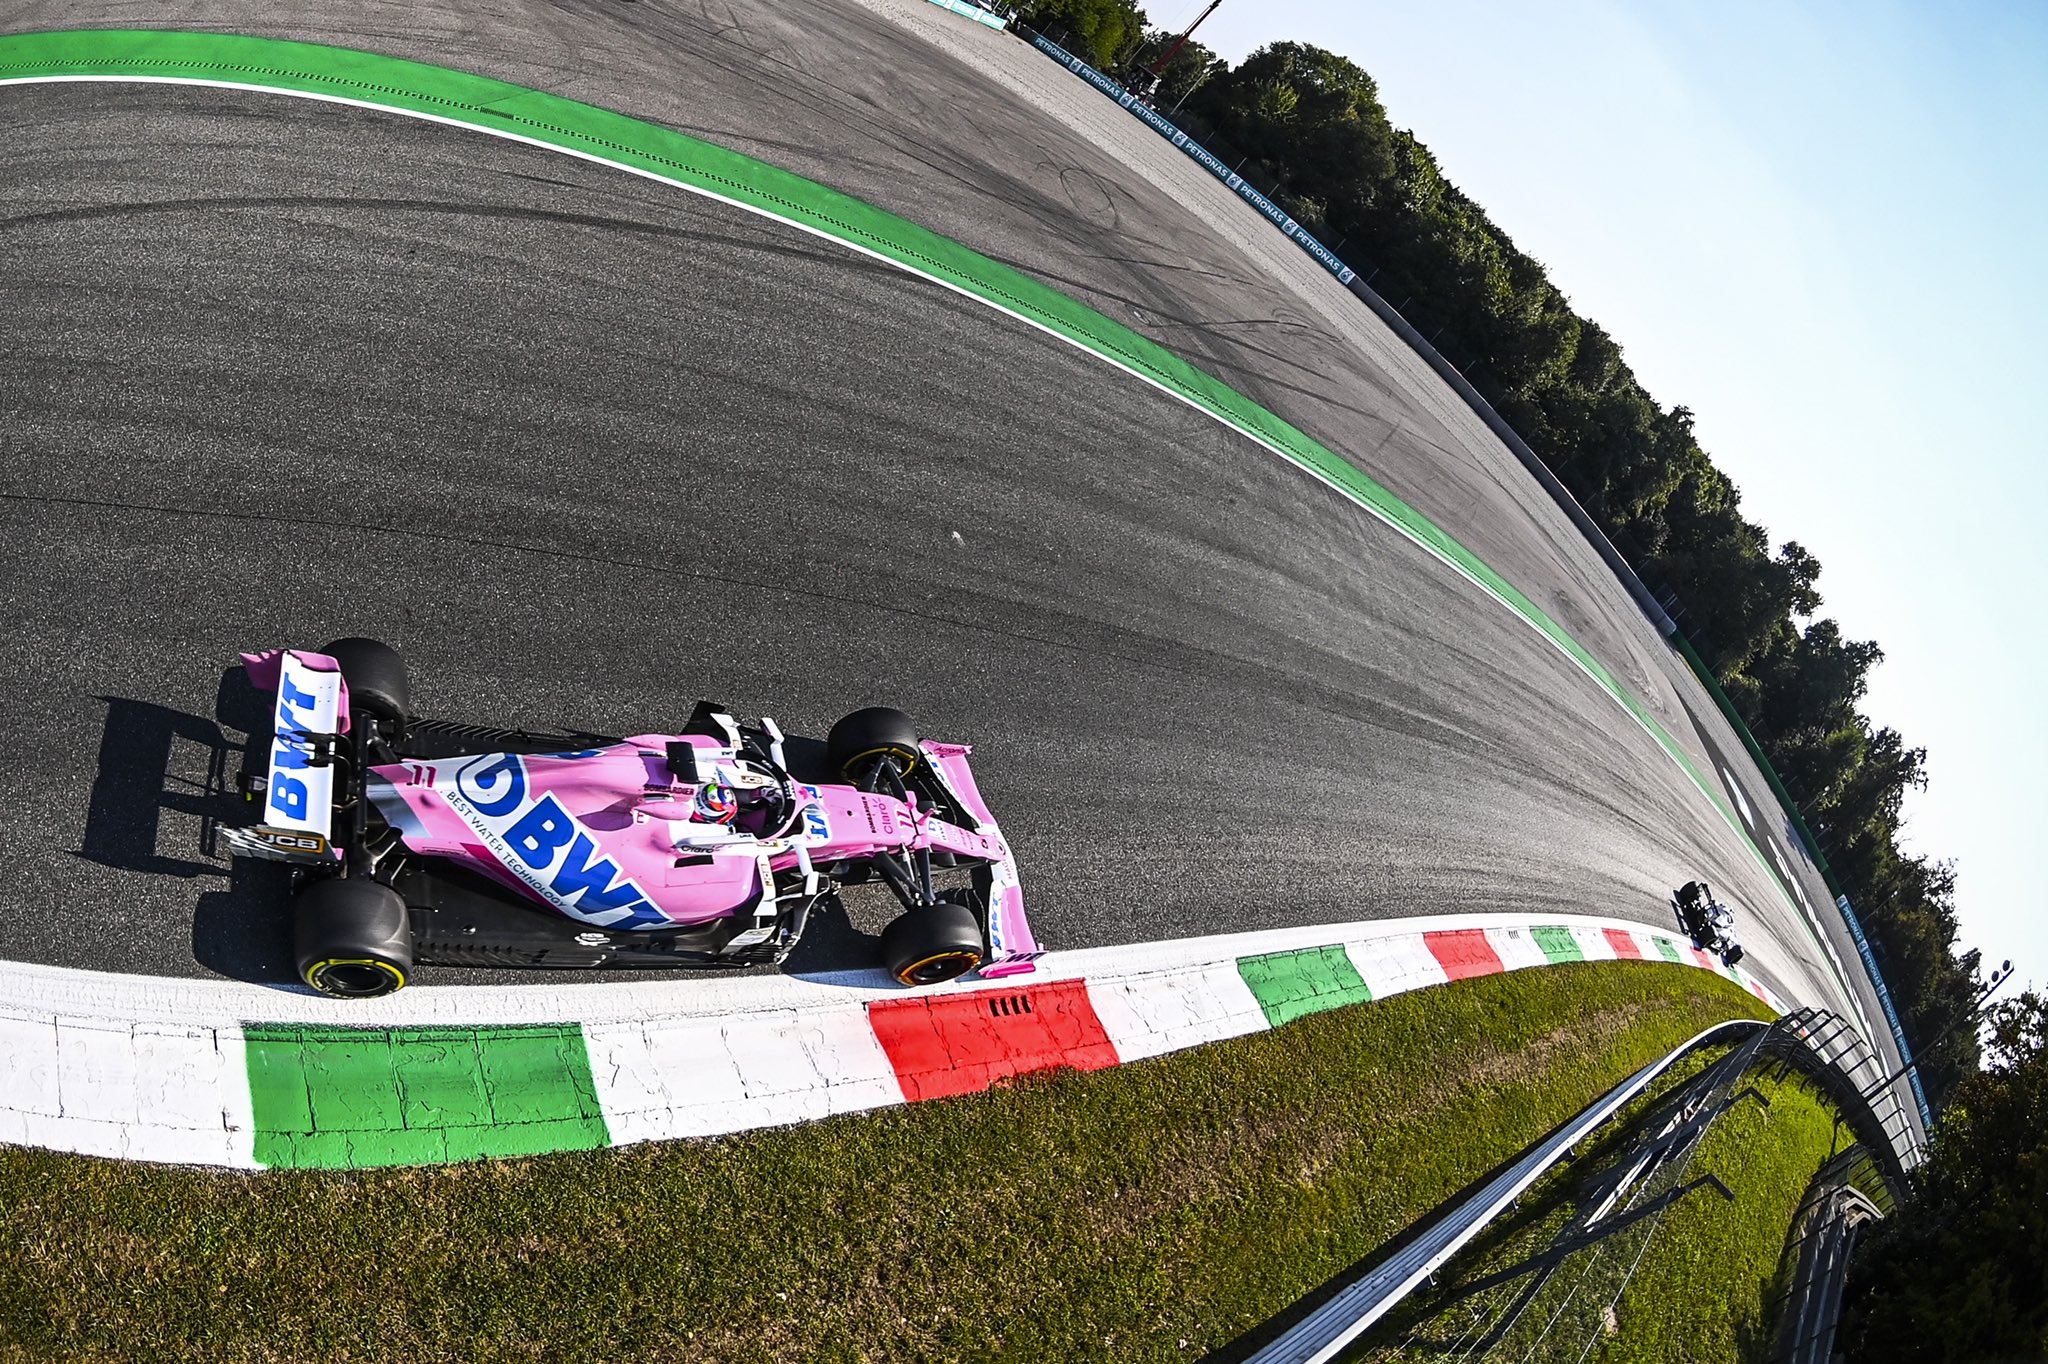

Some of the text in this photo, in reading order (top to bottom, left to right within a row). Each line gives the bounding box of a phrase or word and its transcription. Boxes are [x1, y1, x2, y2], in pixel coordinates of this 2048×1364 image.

[1035, 37, 1071, 64] PETRONAS
[1081, 67, 1120, 97] PETRONAS
[1132, 103, 1174, 135] PETRONAS
[1185, 142, 1228, 177] PETRONAS
[1240, 185, 1284, 222] PETRONAS
[1296, 231, 1340, 270] PETRONAS
[271, 672, 316, 821] BWT
[412, 764, 437, 788] 11
[643, 783, 695, 796] BOMBARDIER
[878, 802, 894, 835] Claro
[896, 810, 914, 828] 11
[267, 834, 319, 849] JCB
[446, 791, 568, 908] BEST WATER TECHNOLOGY
[681, 844, 714, 854] Claro
[501, 795, 670, 930] BWT
[1843, 906, 1862, 941] PETRONAS
[1864, 951, 1880, 986] PETRONAS
[1883, 995, 1898, 1028] PETRONAS
[1898, 1037, 1911, 1064] PETRONA
